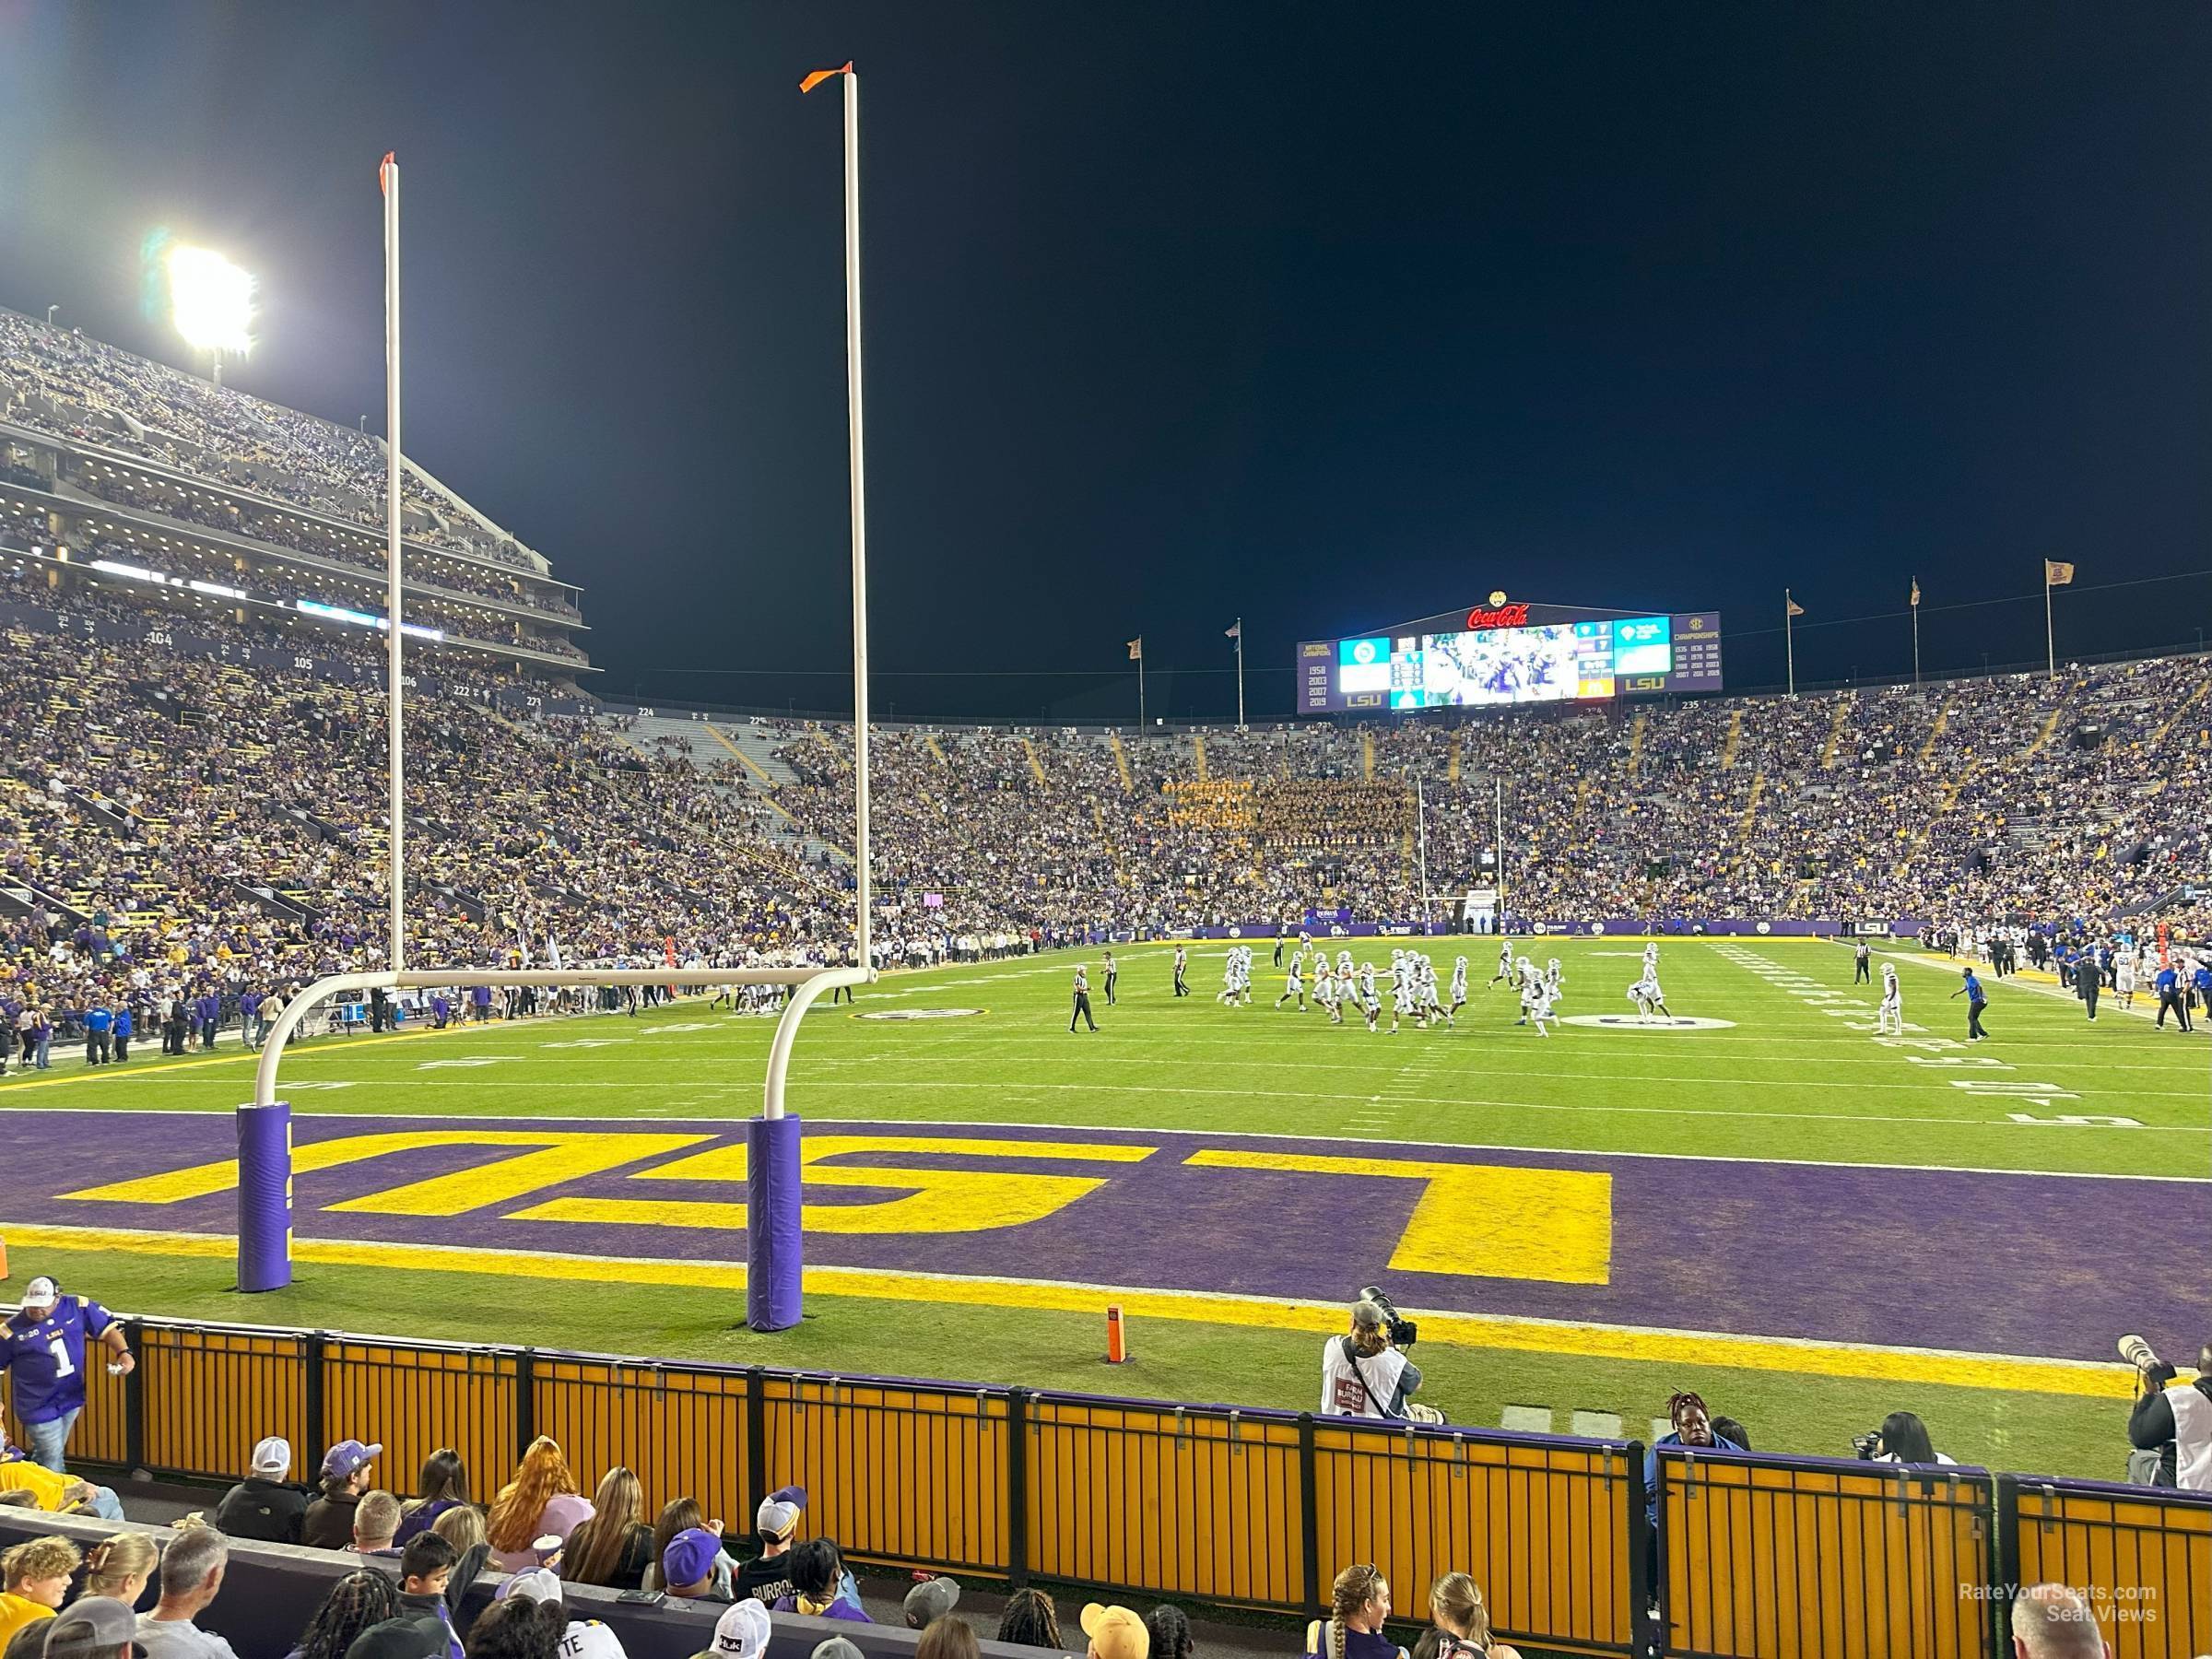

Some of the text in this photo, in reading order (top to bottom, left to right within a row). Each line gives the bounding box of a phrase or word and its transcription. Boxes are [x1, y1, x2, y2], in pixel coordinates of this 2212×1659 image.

[1467, 605, 1529, 629] Coca-Cola
[294, 657, 312, 670] 105
[1309, 665, 1326, 675] 1958
[1309, 677, 1326, 685] 2003
[1625, 677, 1665, 691] LSU
[453, 686, 470, 697] 222
[1309, 688, 1326, 696] 2007
[1891, 685, 1910, 694] 237
[1310, 698, 1326, 706] 2019
[1347, 694, 1382, 707] LSU
[1682, 700, 1700, 710] 235
[638, 707, 654, 717] 224
[1234, 724, 1249, 733] 20
[1855, 923, 1888, 934] LSU
[46, 1328, 64, 1340] LSU
[50, 1338, 75, 1378] 1
[1346, 1383, 1363, 1395] FARM
[1337, 1389, 1363, 1403] BUREAU
